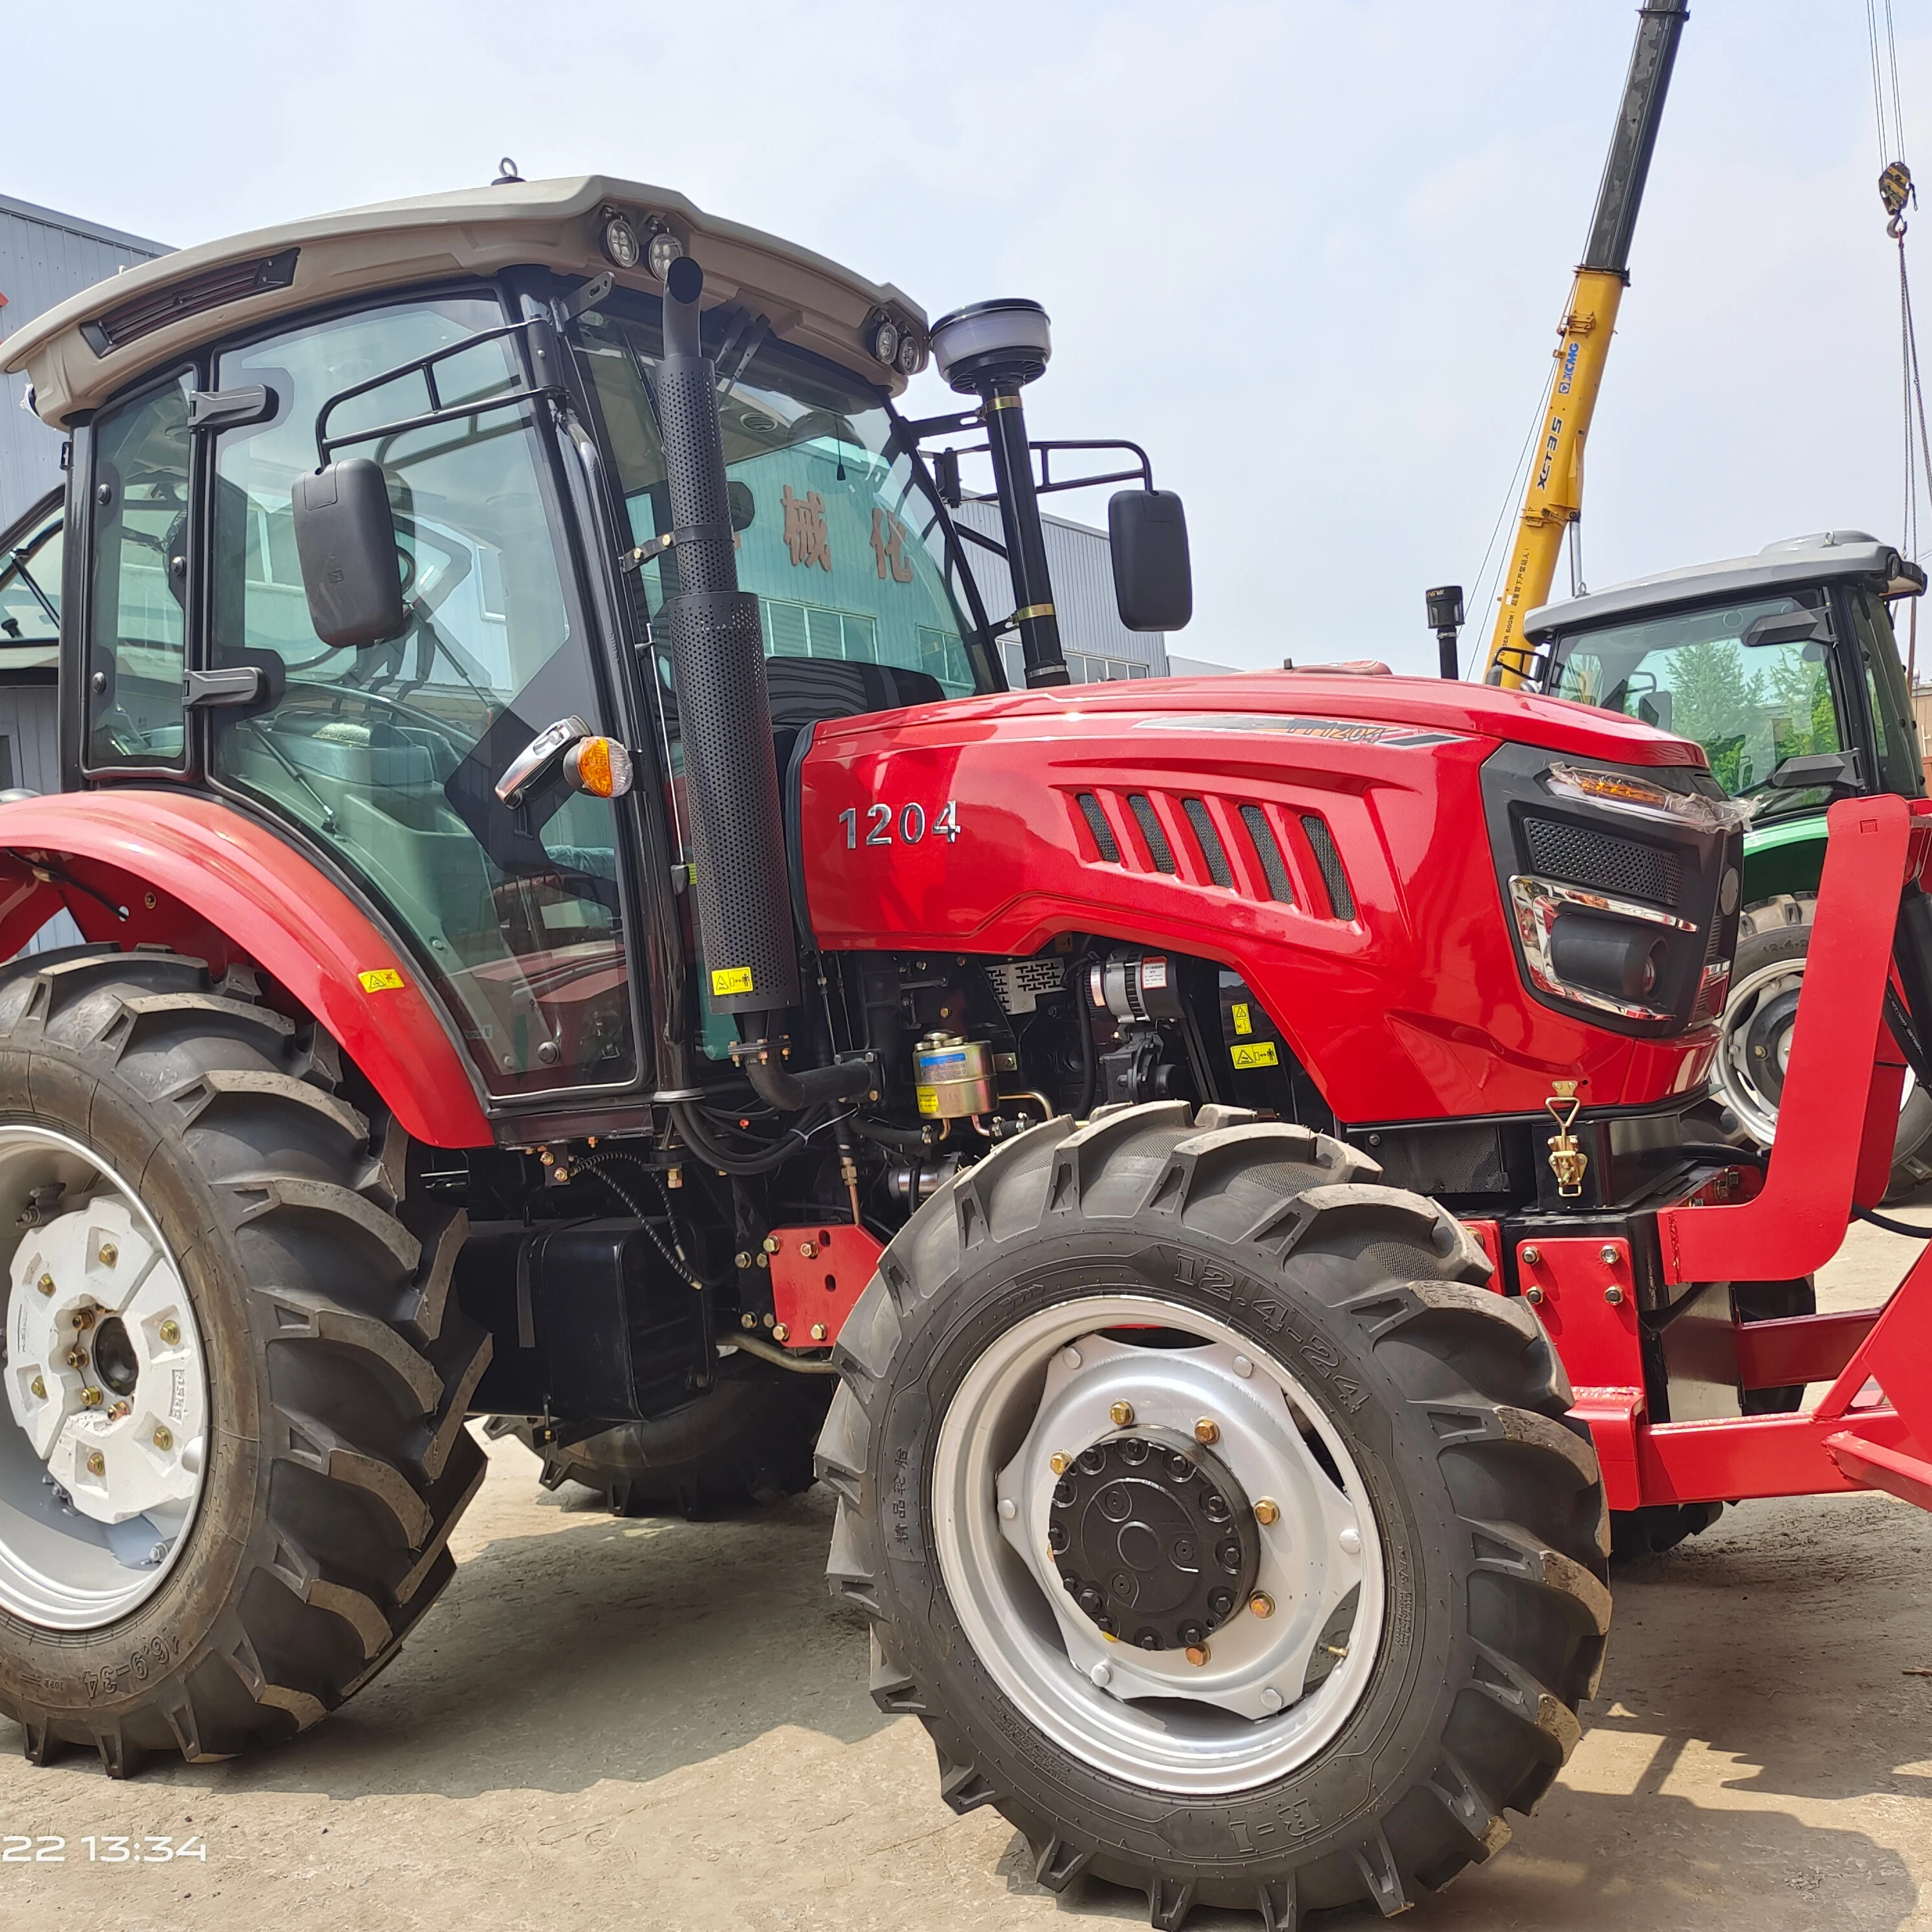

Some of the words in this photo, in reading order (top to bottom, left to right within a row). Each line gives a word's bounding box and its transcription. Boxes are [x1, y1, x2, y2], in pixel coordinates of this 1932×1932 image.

[1562, 342, 1580, 382] XCMG
[1537, 416, 1563, 491] XCT35
[735, 484, 914, 583] 械化
[1500, 635, 1510, 656] UDER
[838, 800, 961, 849] 1204
[1761, 938, 1809, 954] 12.4-2
[1174, 1253, 1372, 1414] 12.4-24
[892, 1446, 909, 1545] 精品轮胎
[82, 1627, 180, 1700] 16.9-34
[1229, 1797, 1321, 1853] R-1
